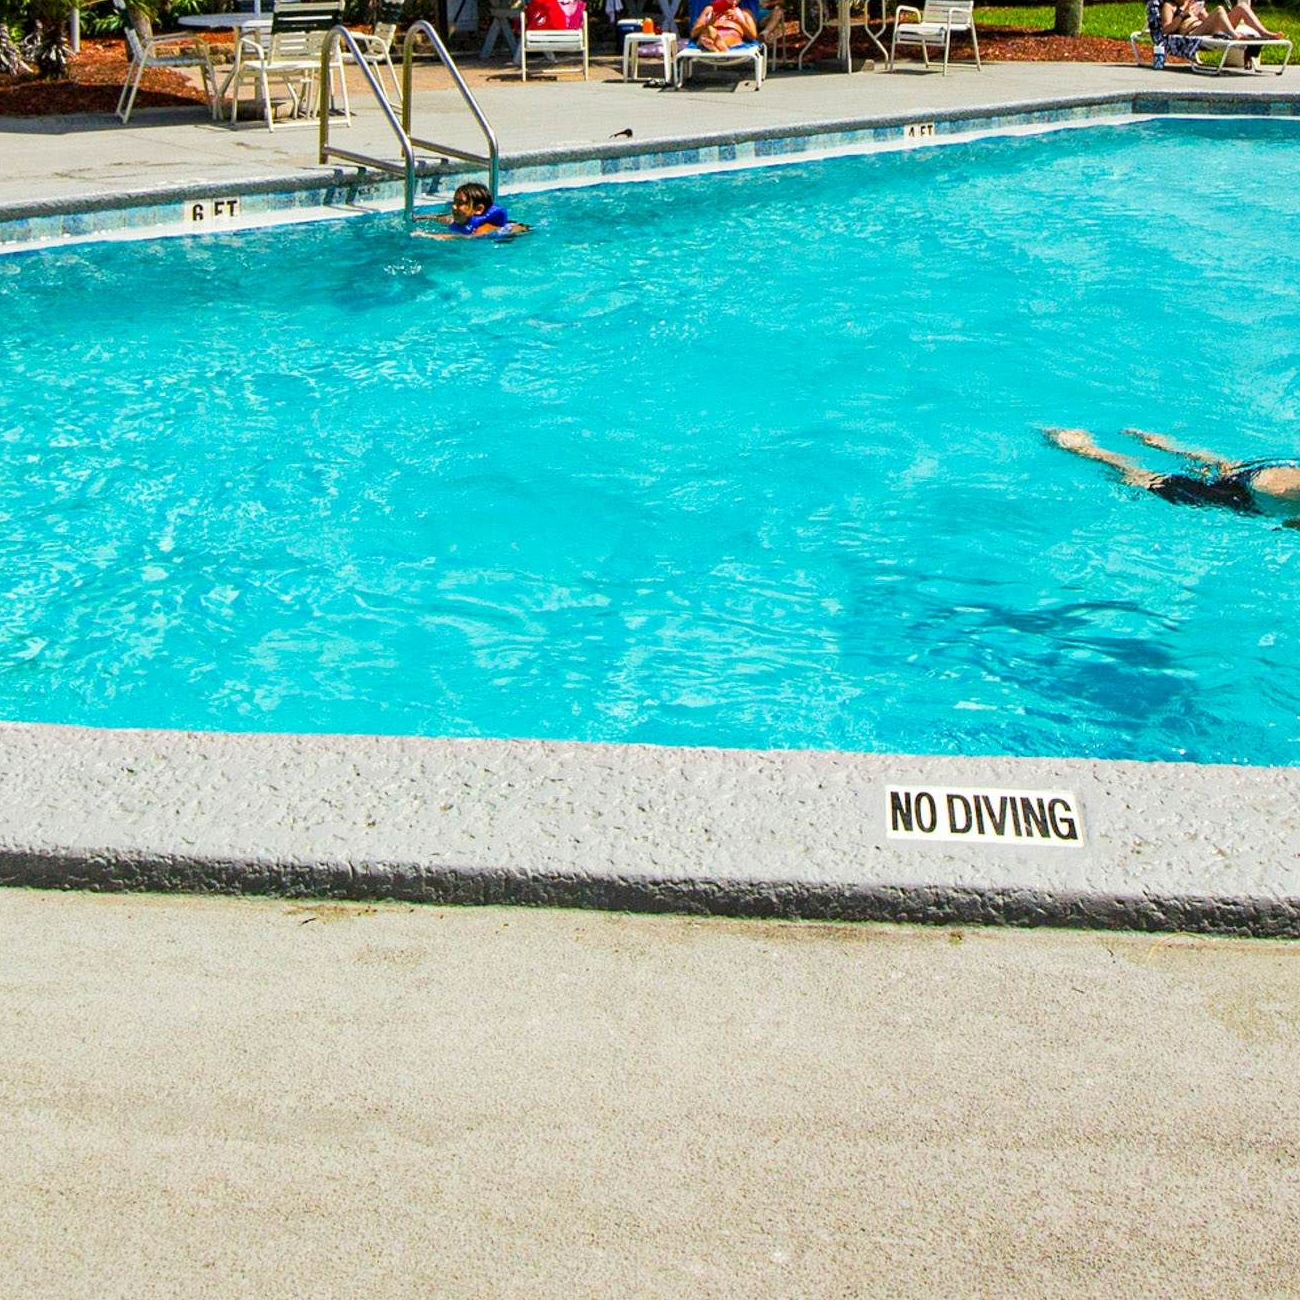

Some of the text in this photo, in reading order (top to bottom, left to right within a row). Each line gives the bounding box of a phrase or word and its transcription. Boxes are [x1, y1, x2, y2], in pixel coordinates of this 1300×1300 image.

[214, 200, 238, 217] FT
[890, 791, 1079, 840] NO DIVING
